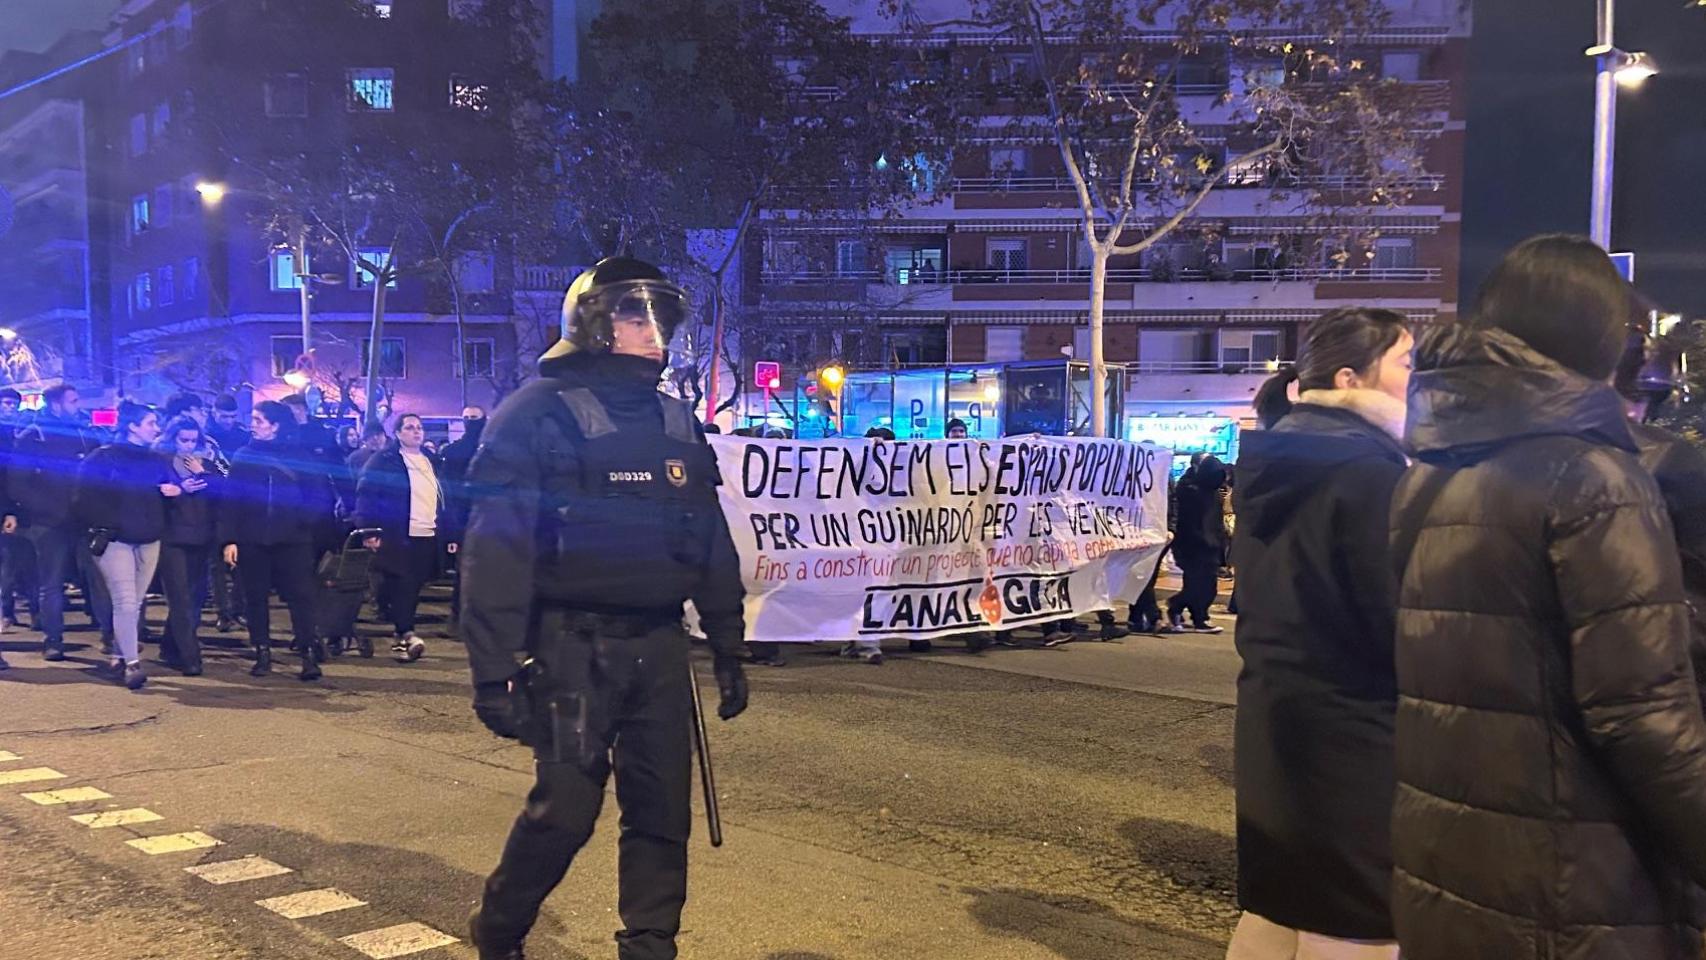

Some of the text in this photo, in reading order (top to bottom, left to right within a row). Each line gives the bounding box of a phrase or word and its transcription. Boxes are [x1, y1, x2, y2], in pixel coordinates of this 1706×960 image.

[742, 442, 1155, 499] DEFENSEM ELS ESPAIS POPULARS
[750, 512, 808, 550] PER
[810, 512, 852, 547] UN
[981, 503, 1018, 541] PER
[754, 554, 790, 581] Fins
[796, 562, 808, 580] a
[814, 549, 902, 580] construir
[901, 554, 921, 574] un
[986, 545, 1012, 568] que
[1014, 545, 1034, 567] no
